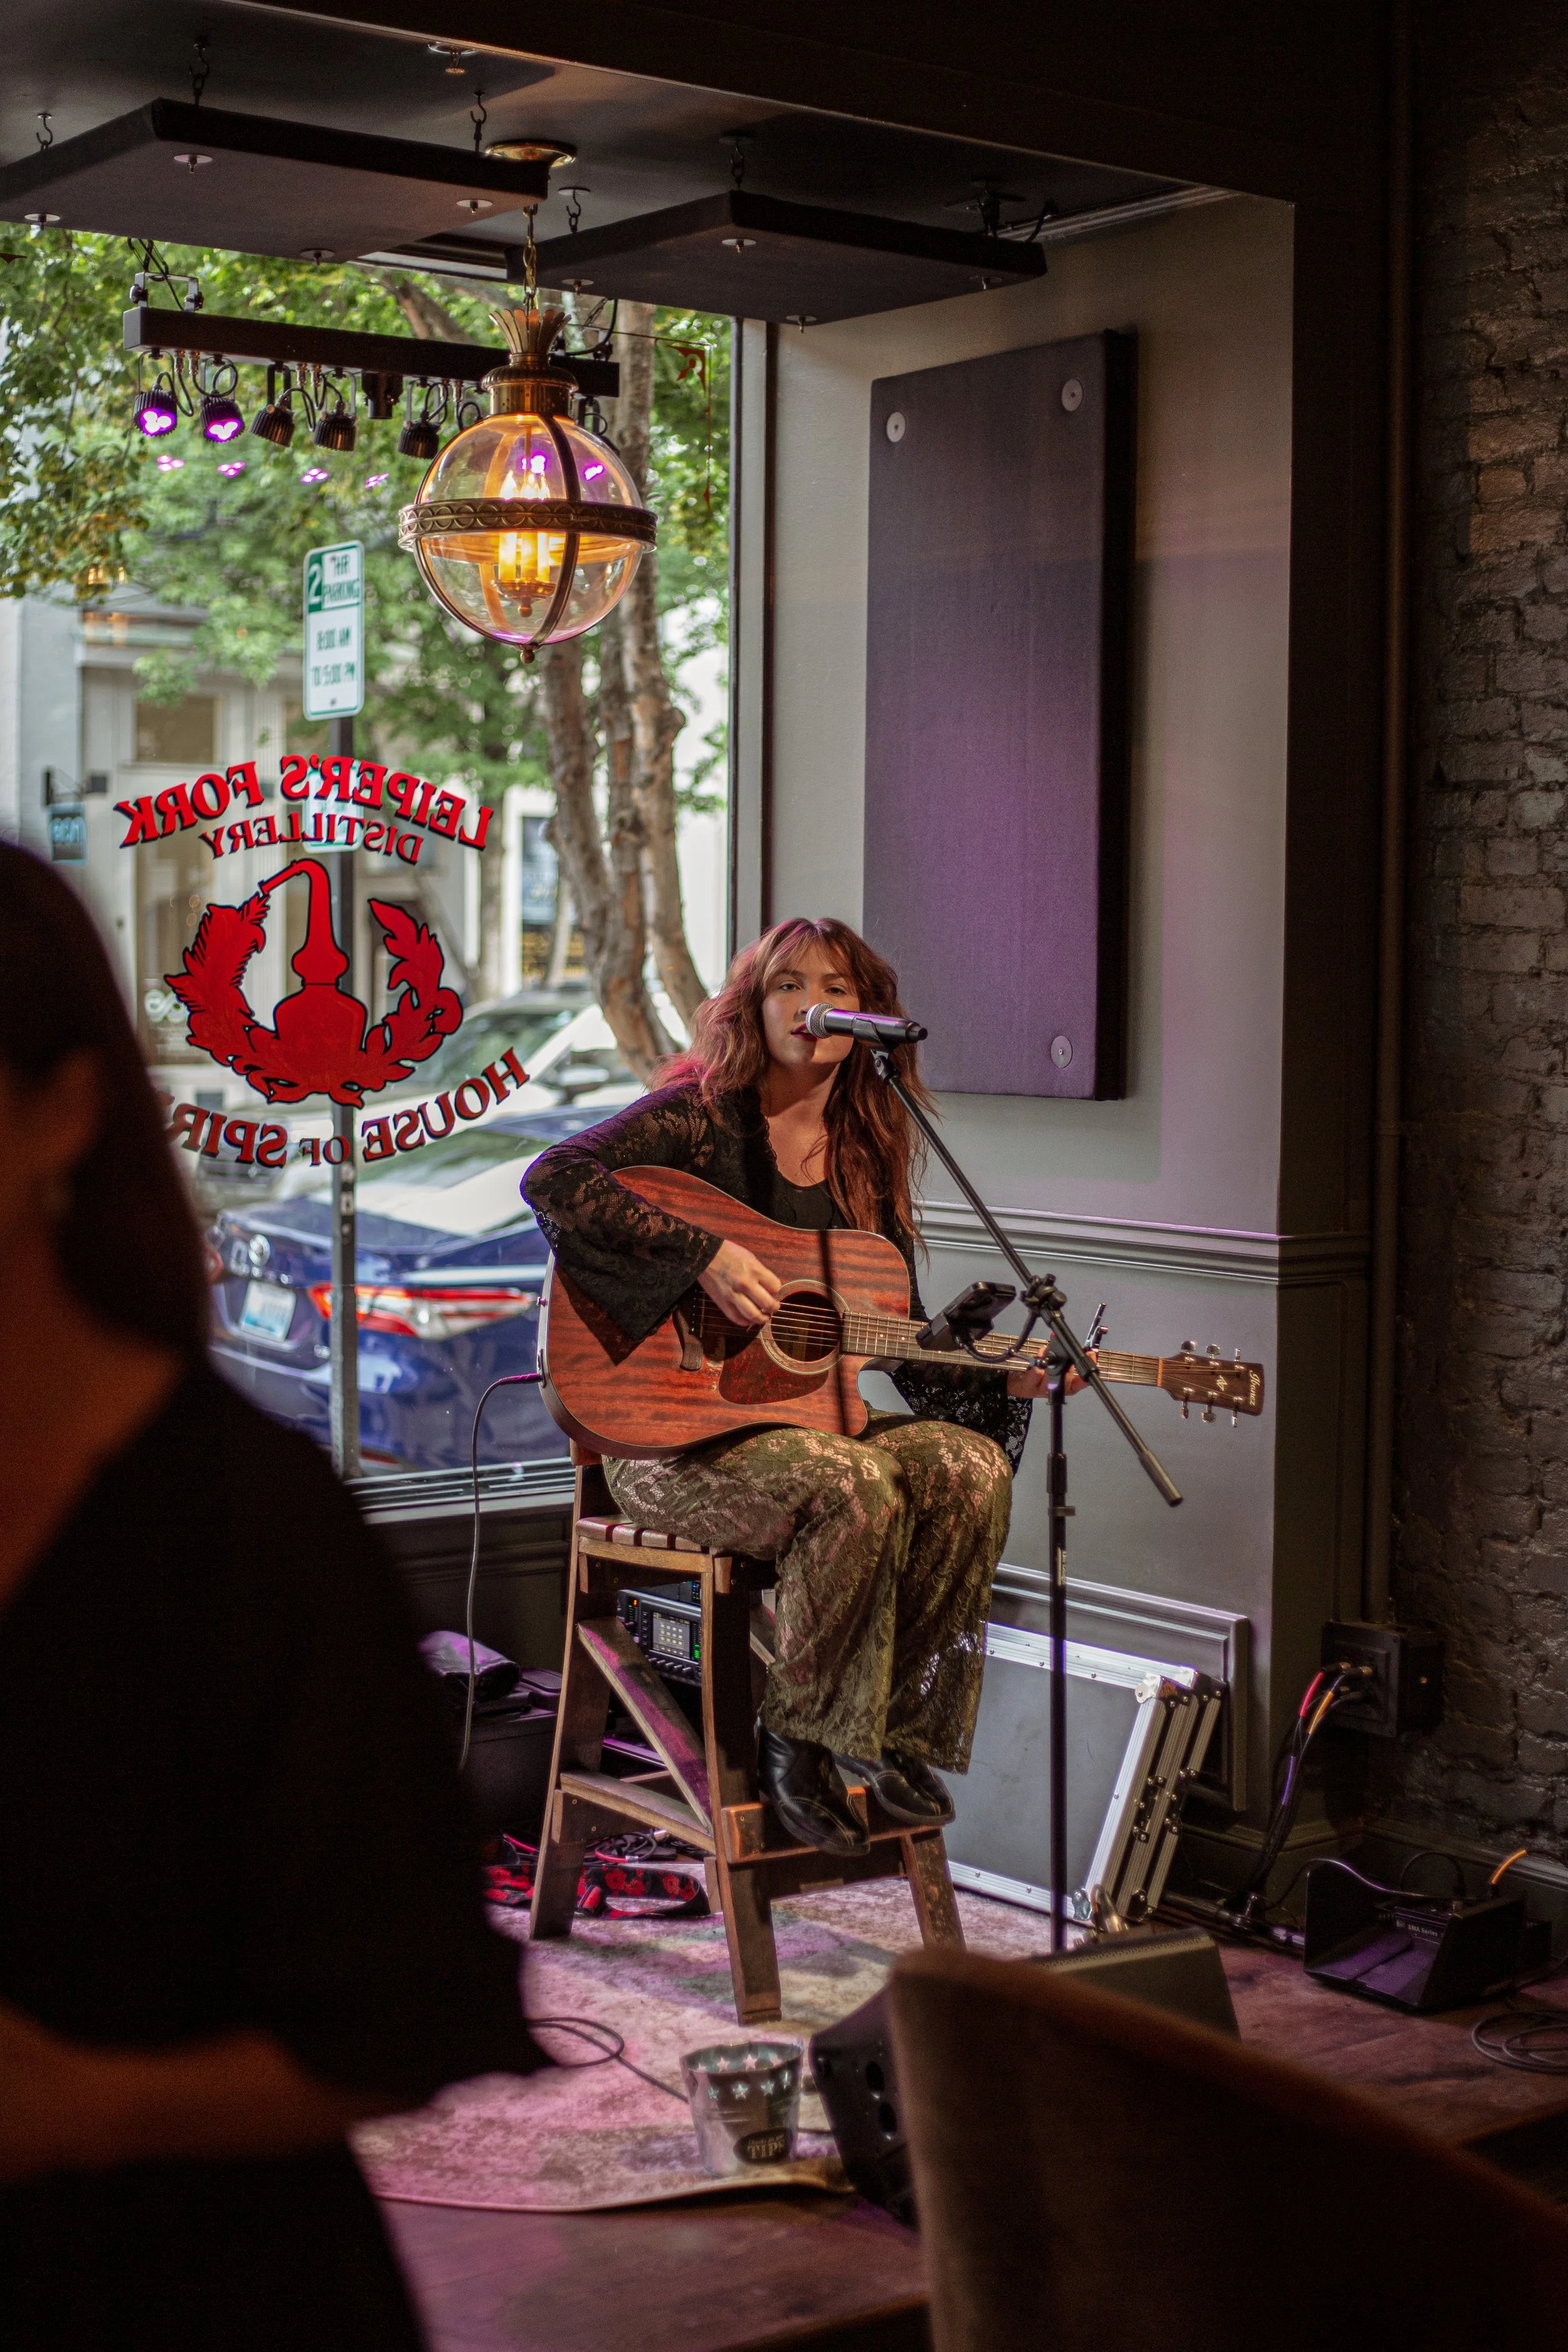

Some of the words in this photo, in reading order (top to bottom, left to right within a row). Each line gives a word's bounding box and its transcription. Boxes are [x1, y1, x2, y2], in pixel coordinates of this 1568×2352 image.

[309, 563, 322, 604] 2
[323, 578, 359, 603] PARKING
[1249, 1370, 1260, 1406] Ibanez
[1408, 1924, 1420, 1932] SMA
[1421, 1928, 1438, 1937] Series
